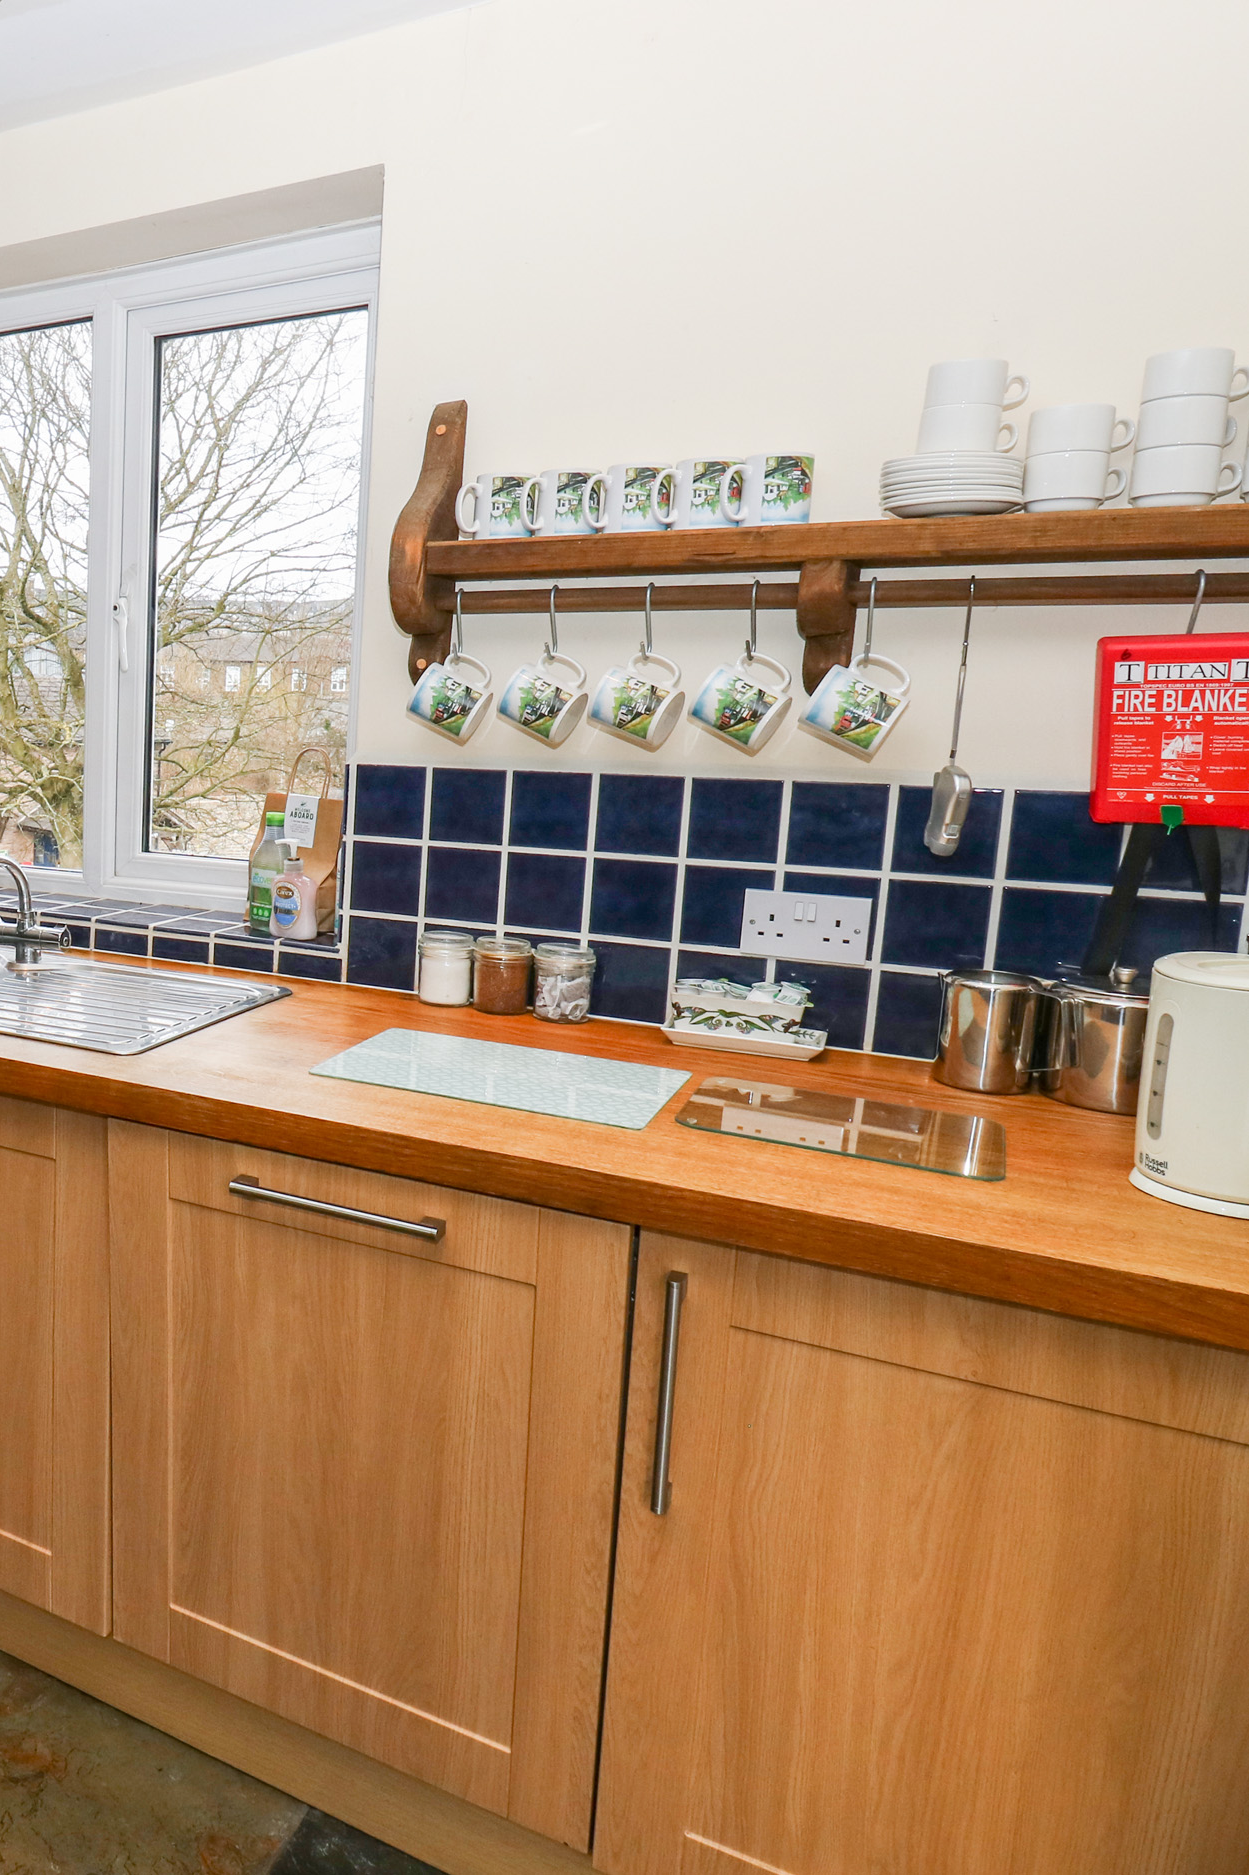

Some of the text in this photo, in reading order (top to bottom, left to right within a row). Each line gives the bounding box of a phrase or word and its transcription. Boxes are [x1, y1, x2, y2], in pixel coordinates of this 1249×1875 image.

[1119, 663, 1141, 682] T
[1148, 663, 1227, 680] TITAN
[1112, 689, 1249, 712] FIRE BLANKE
[289, 811, 314, 820] ABOARD
[252, 875, 272, 885] ecove
[1144, 1161, 1166, 1176] Hobbs
[1145, 1153, 1168, 1170] Russell
